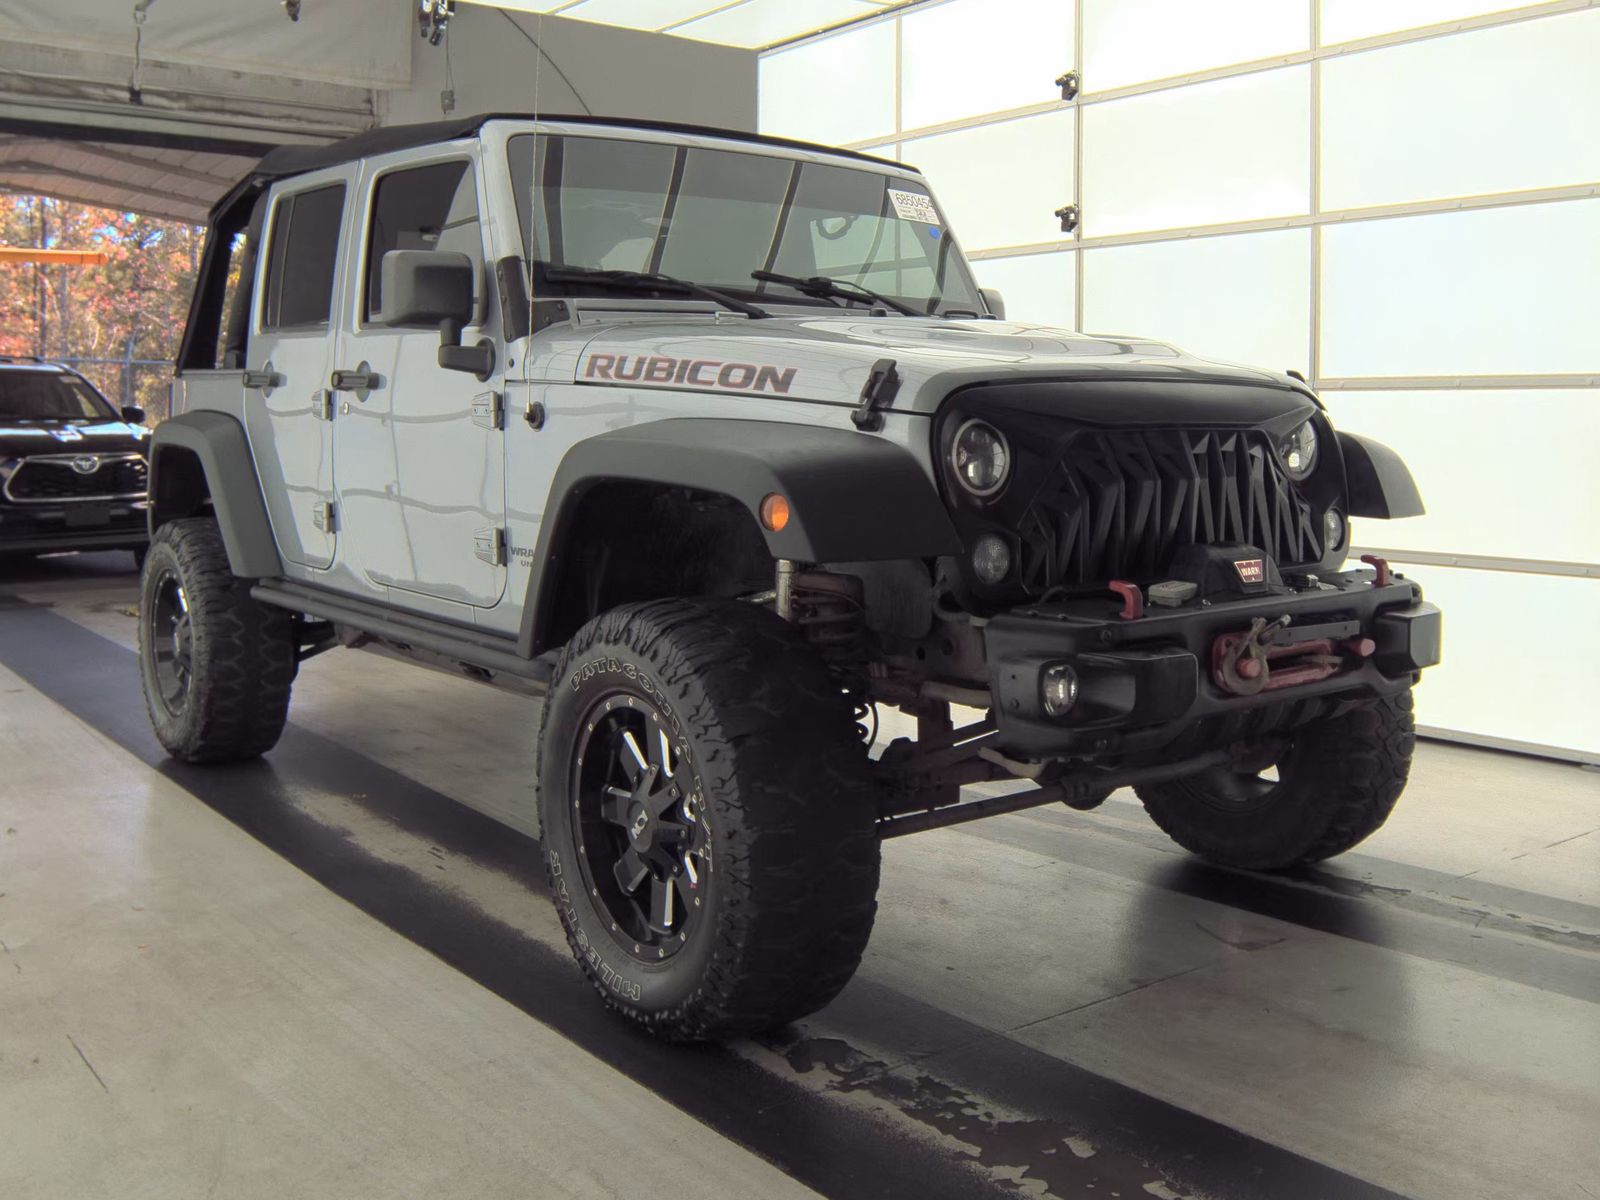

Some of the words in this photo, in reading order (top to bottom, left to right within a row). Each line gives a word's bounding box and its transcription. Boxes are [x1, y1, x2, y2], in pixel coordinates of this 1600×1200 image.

[584, 353, 798, 394] RUBICON
[1240, 566, 1260, 576] WARN
[570, 656, 692, 764] PATAGONIA
[550, 849, 641, 1001] MILESTAR
